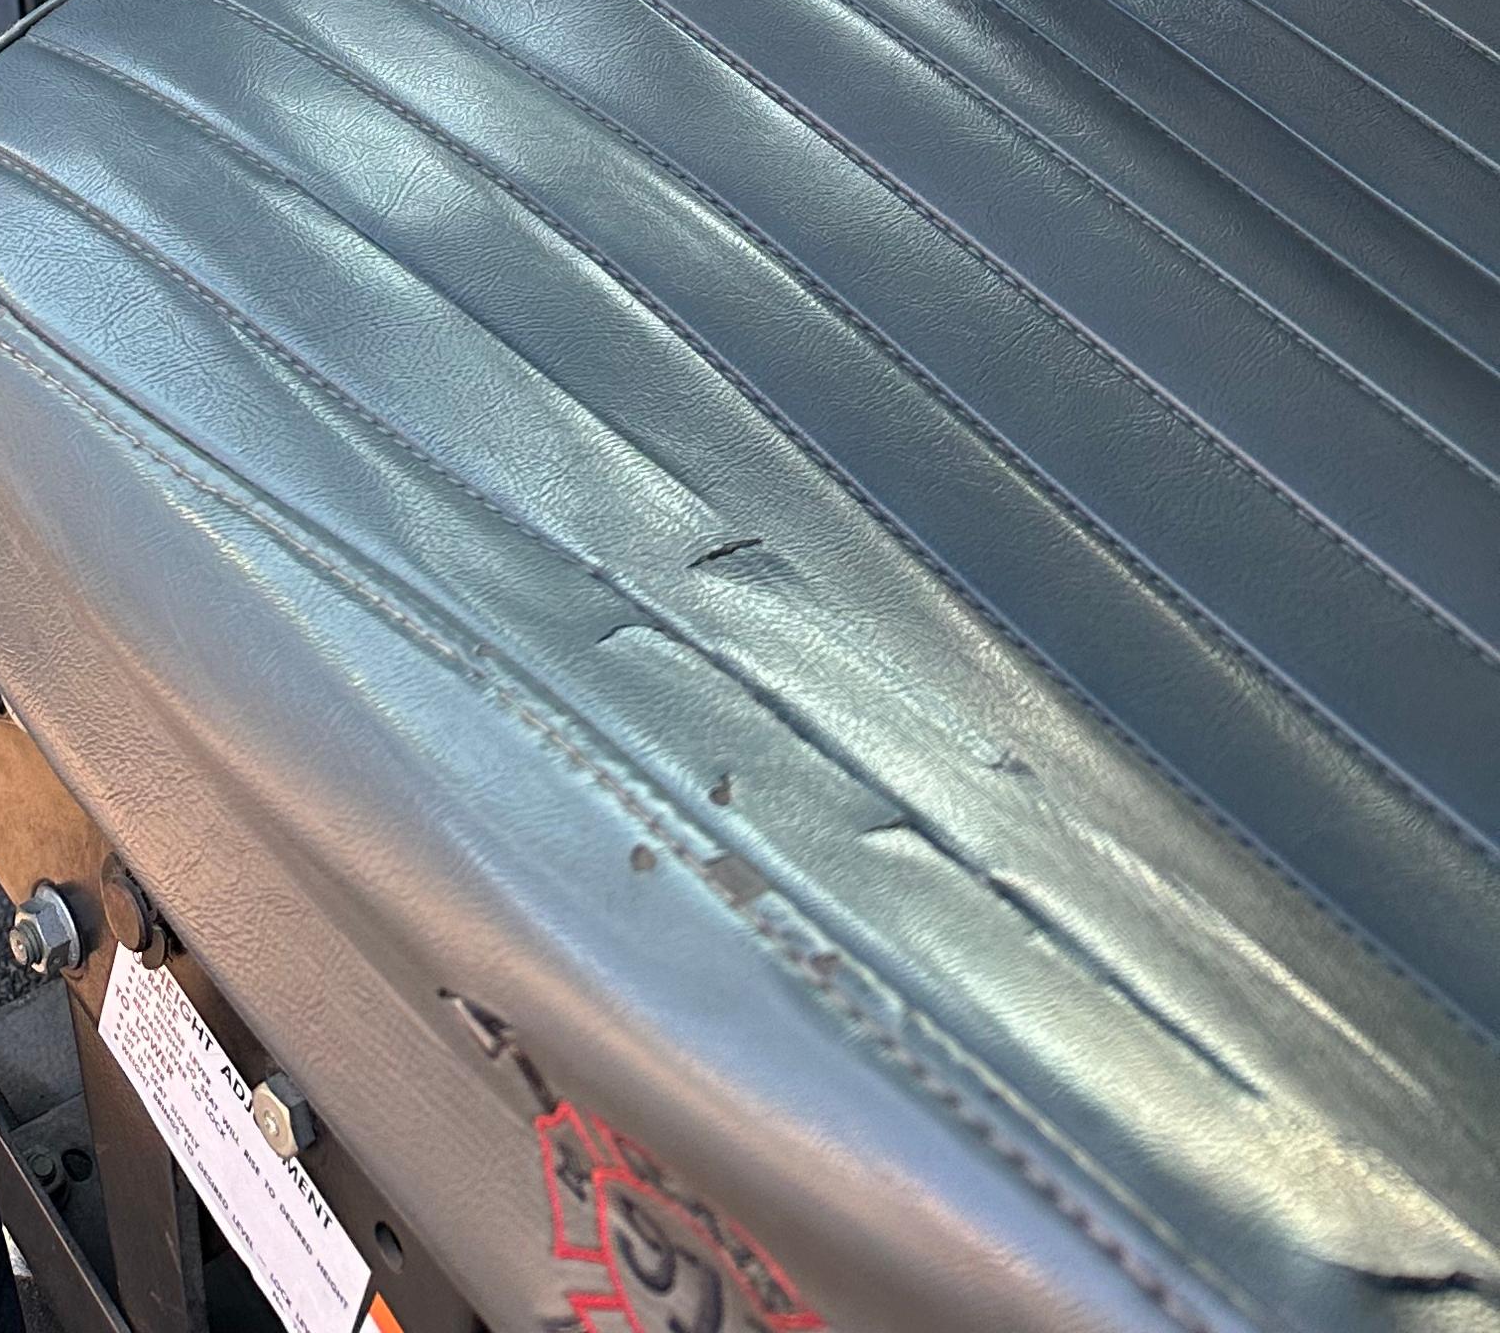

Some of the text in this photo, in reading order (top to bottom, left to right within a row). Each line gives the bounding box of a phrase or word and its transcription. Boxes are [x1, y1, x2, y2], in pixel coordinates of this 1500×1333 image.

[115, 984, 174, 1079] TO LOWER
[126, 1021, 165, 1082] LIFT LEVER
[137, 974, 211, 1087] LIFT RELEASE LEVER
[147, 972, 178, 1022] RAISE
[132, 996, 226, 1139] RELEASE LEVER TO LOCK
[149, 1072, 167, 1099] SEAT
[170, 1103, 199, 1148] SLOWLY
[154, 969, 334, 1230] HEIGHT ADJMENT
[121, 1042, 150, 1087] WEIGHT
[152, 1091, 179, 1134] BRINGS
[183, 1138, 194, 1156] TO
[197, 1160, 228, 1210] DESIRED
[231, 1213, 253, 1250] LEVEL
[269, 1272, 291, 1307] LOCK
[134, 985, 348, 1309] LIFT WEIGHT SO SEAT WILL RISE TO DESIRED HEIGHT
